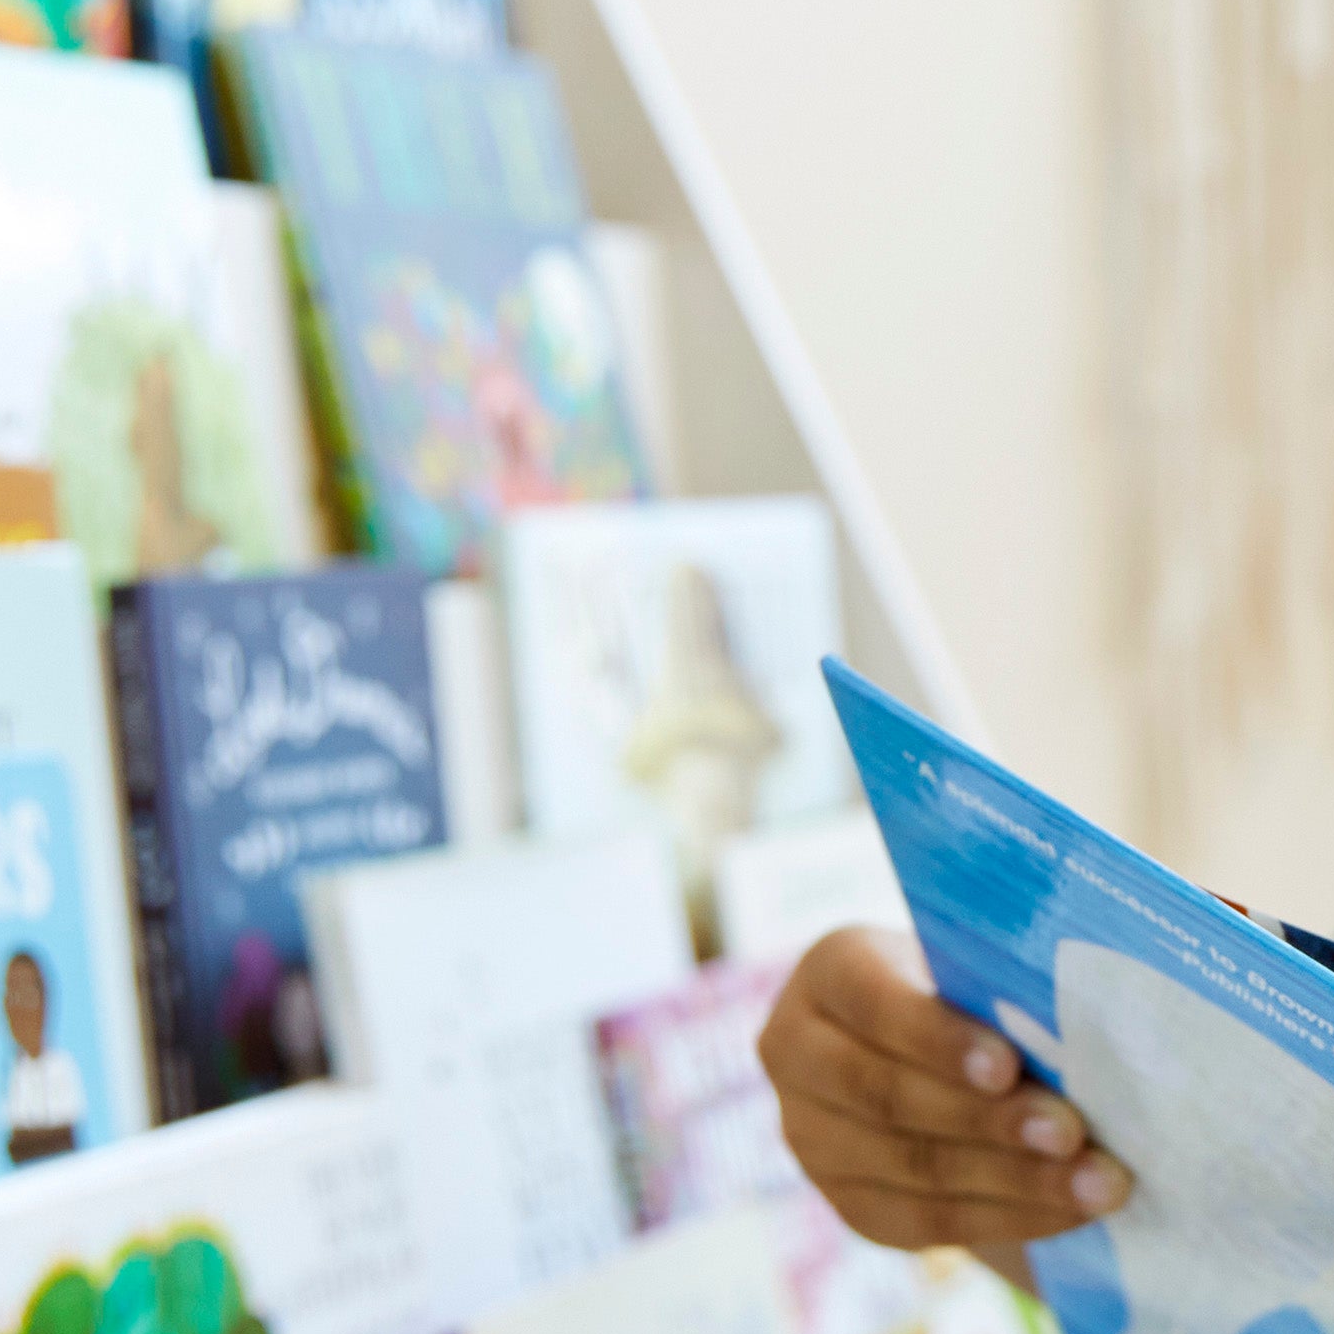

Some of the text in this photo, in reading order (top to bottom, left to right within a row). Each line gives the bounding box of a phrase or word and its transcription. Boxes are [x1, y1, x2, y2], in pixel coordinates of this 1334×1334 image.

[1064, 855, 1199, 948] successor
[1209, 945, 1237, 972] to
[1246, 969, 1334, 1035] Brown
